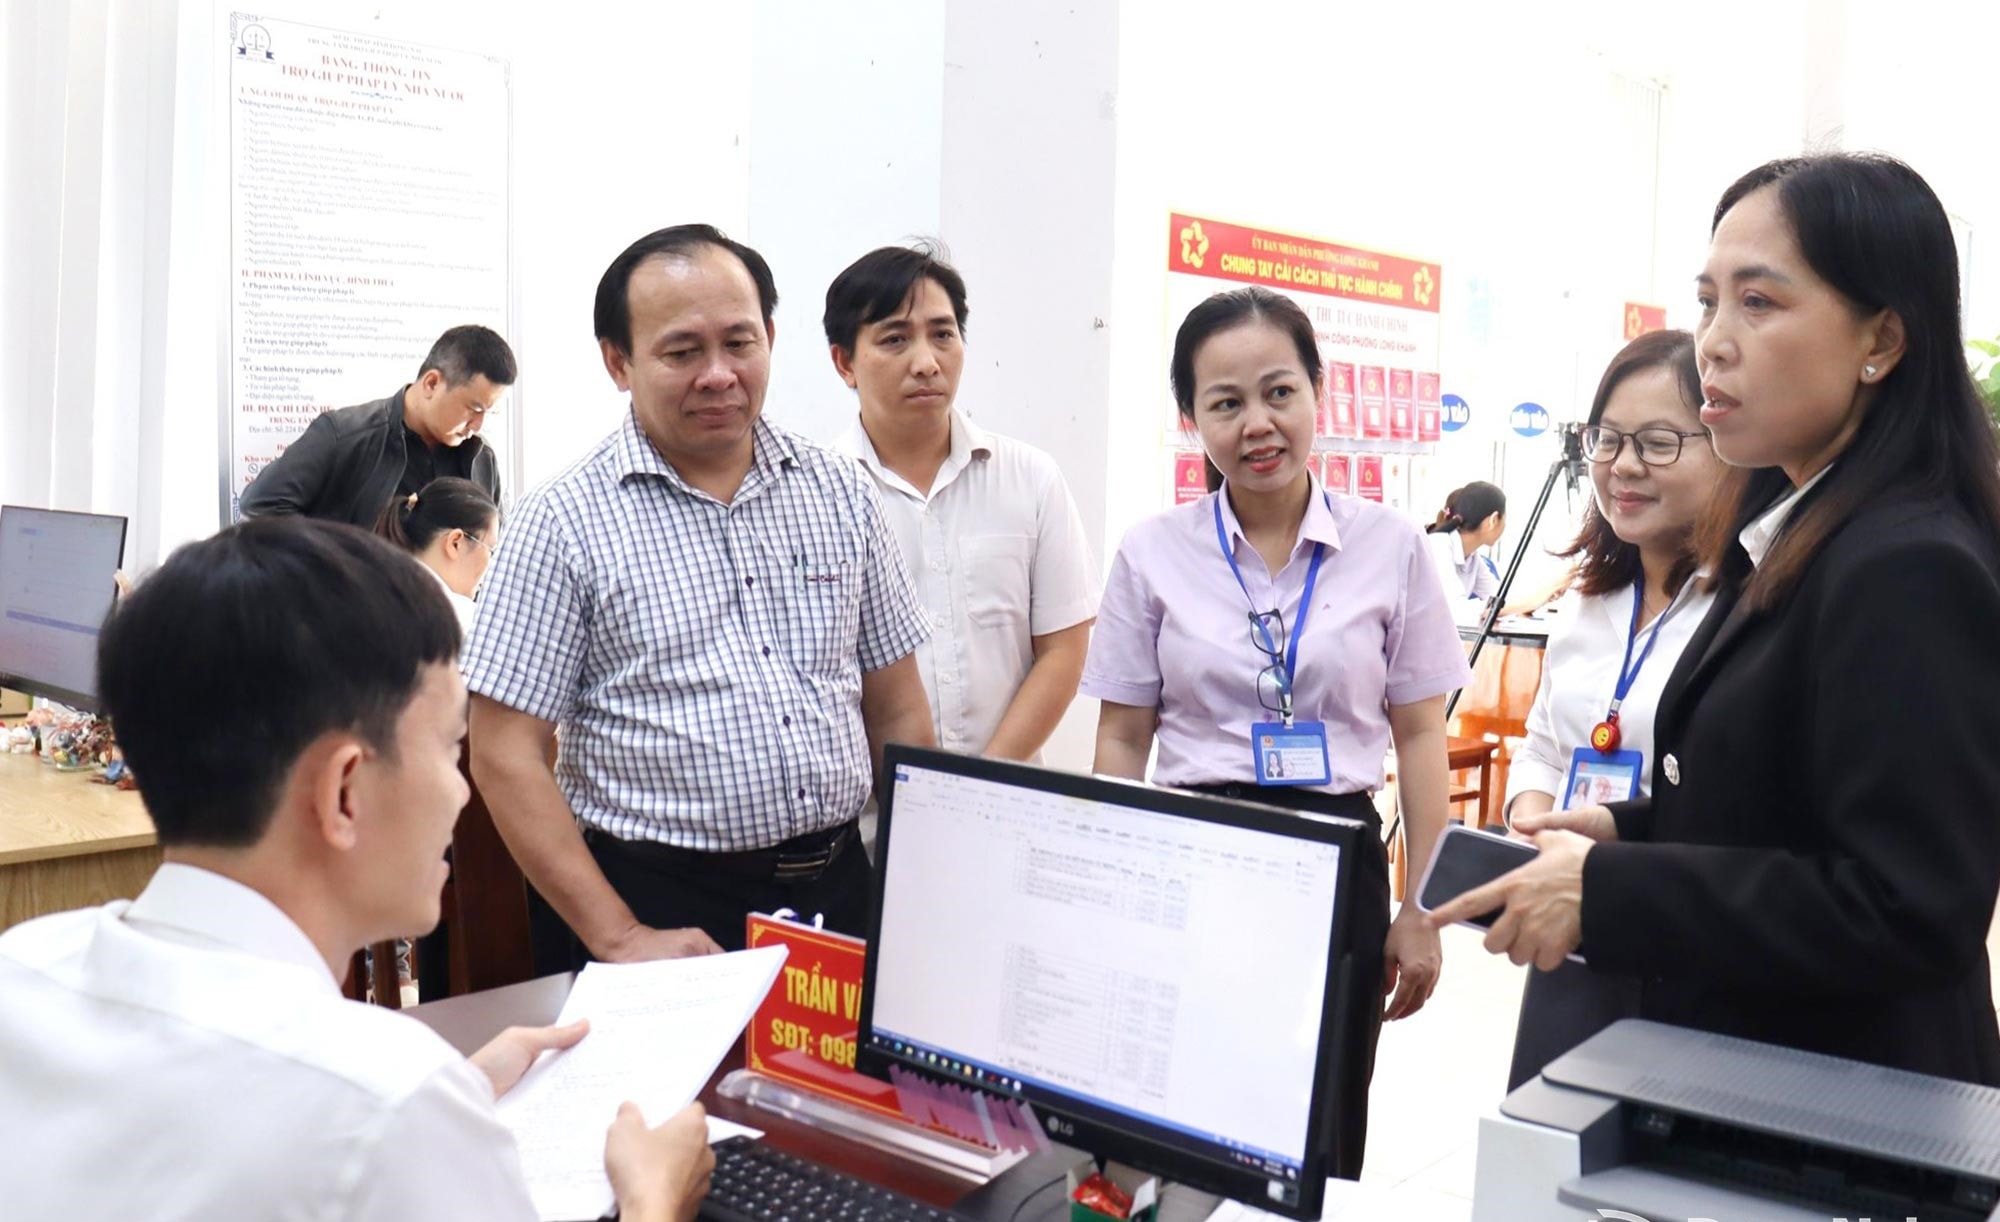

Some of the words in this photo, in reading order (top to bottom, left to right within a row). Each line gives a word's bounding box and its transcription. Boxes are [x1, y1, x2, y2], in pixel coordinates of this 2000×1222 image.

[1221, 253, 1256, 275] CHUNG
[1258, 260, 1273, 277] TAY
[1275, 259, 1292, 281] CẢI
[1293, 263, 1319, 285] CÁCH
[784, 960, 838, 1016] TRẦN
[771, 1017, 814, 1056] SĐT:
